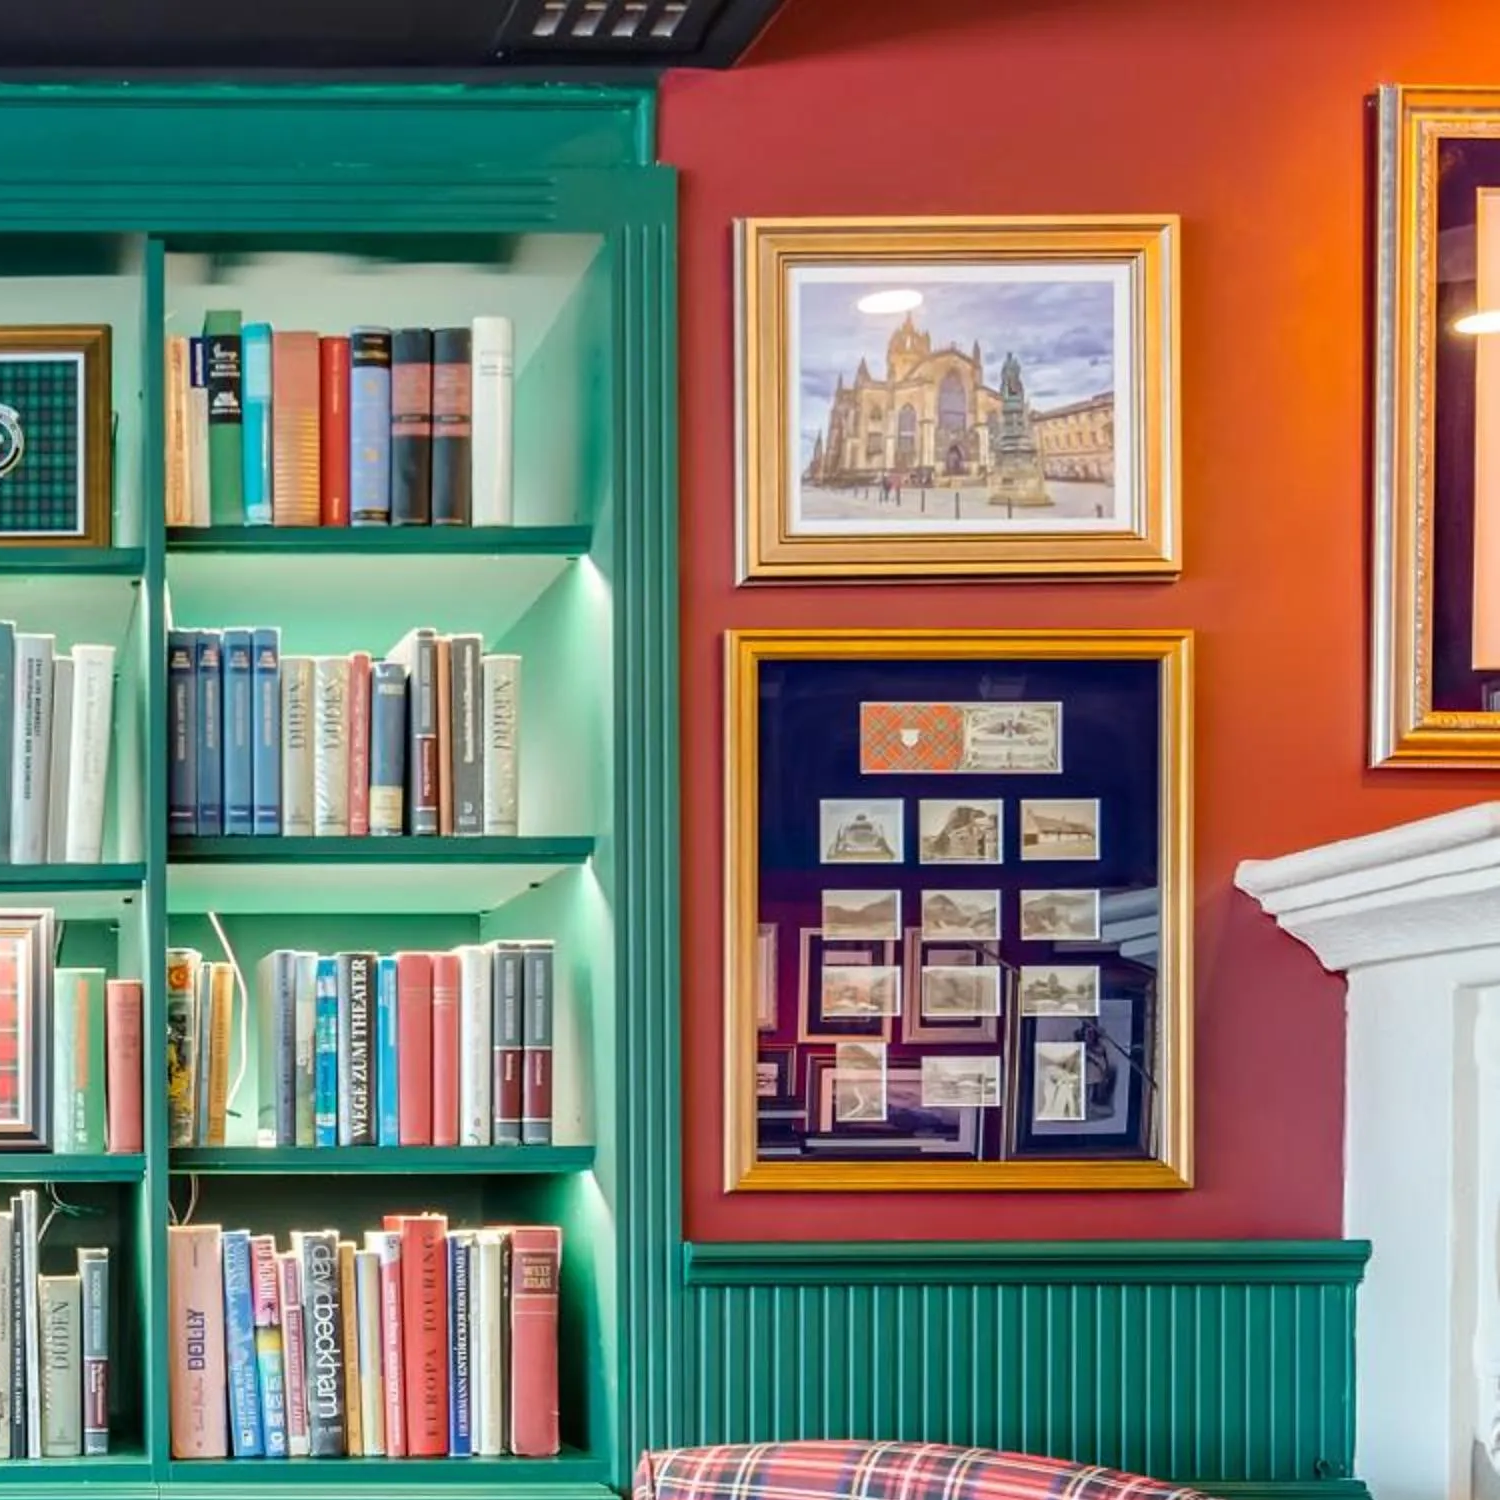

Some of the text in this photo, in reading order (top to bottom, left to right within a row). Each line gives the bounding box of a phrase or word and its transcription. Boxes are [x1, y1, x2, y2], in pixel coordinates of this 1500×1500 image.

[351, 959, 368, 1137] WEGE ZUM THEATER
[52, 1301, 71, 1370] DUDEN
[423, 1234, 438, 1438] EUROPA TOURING
